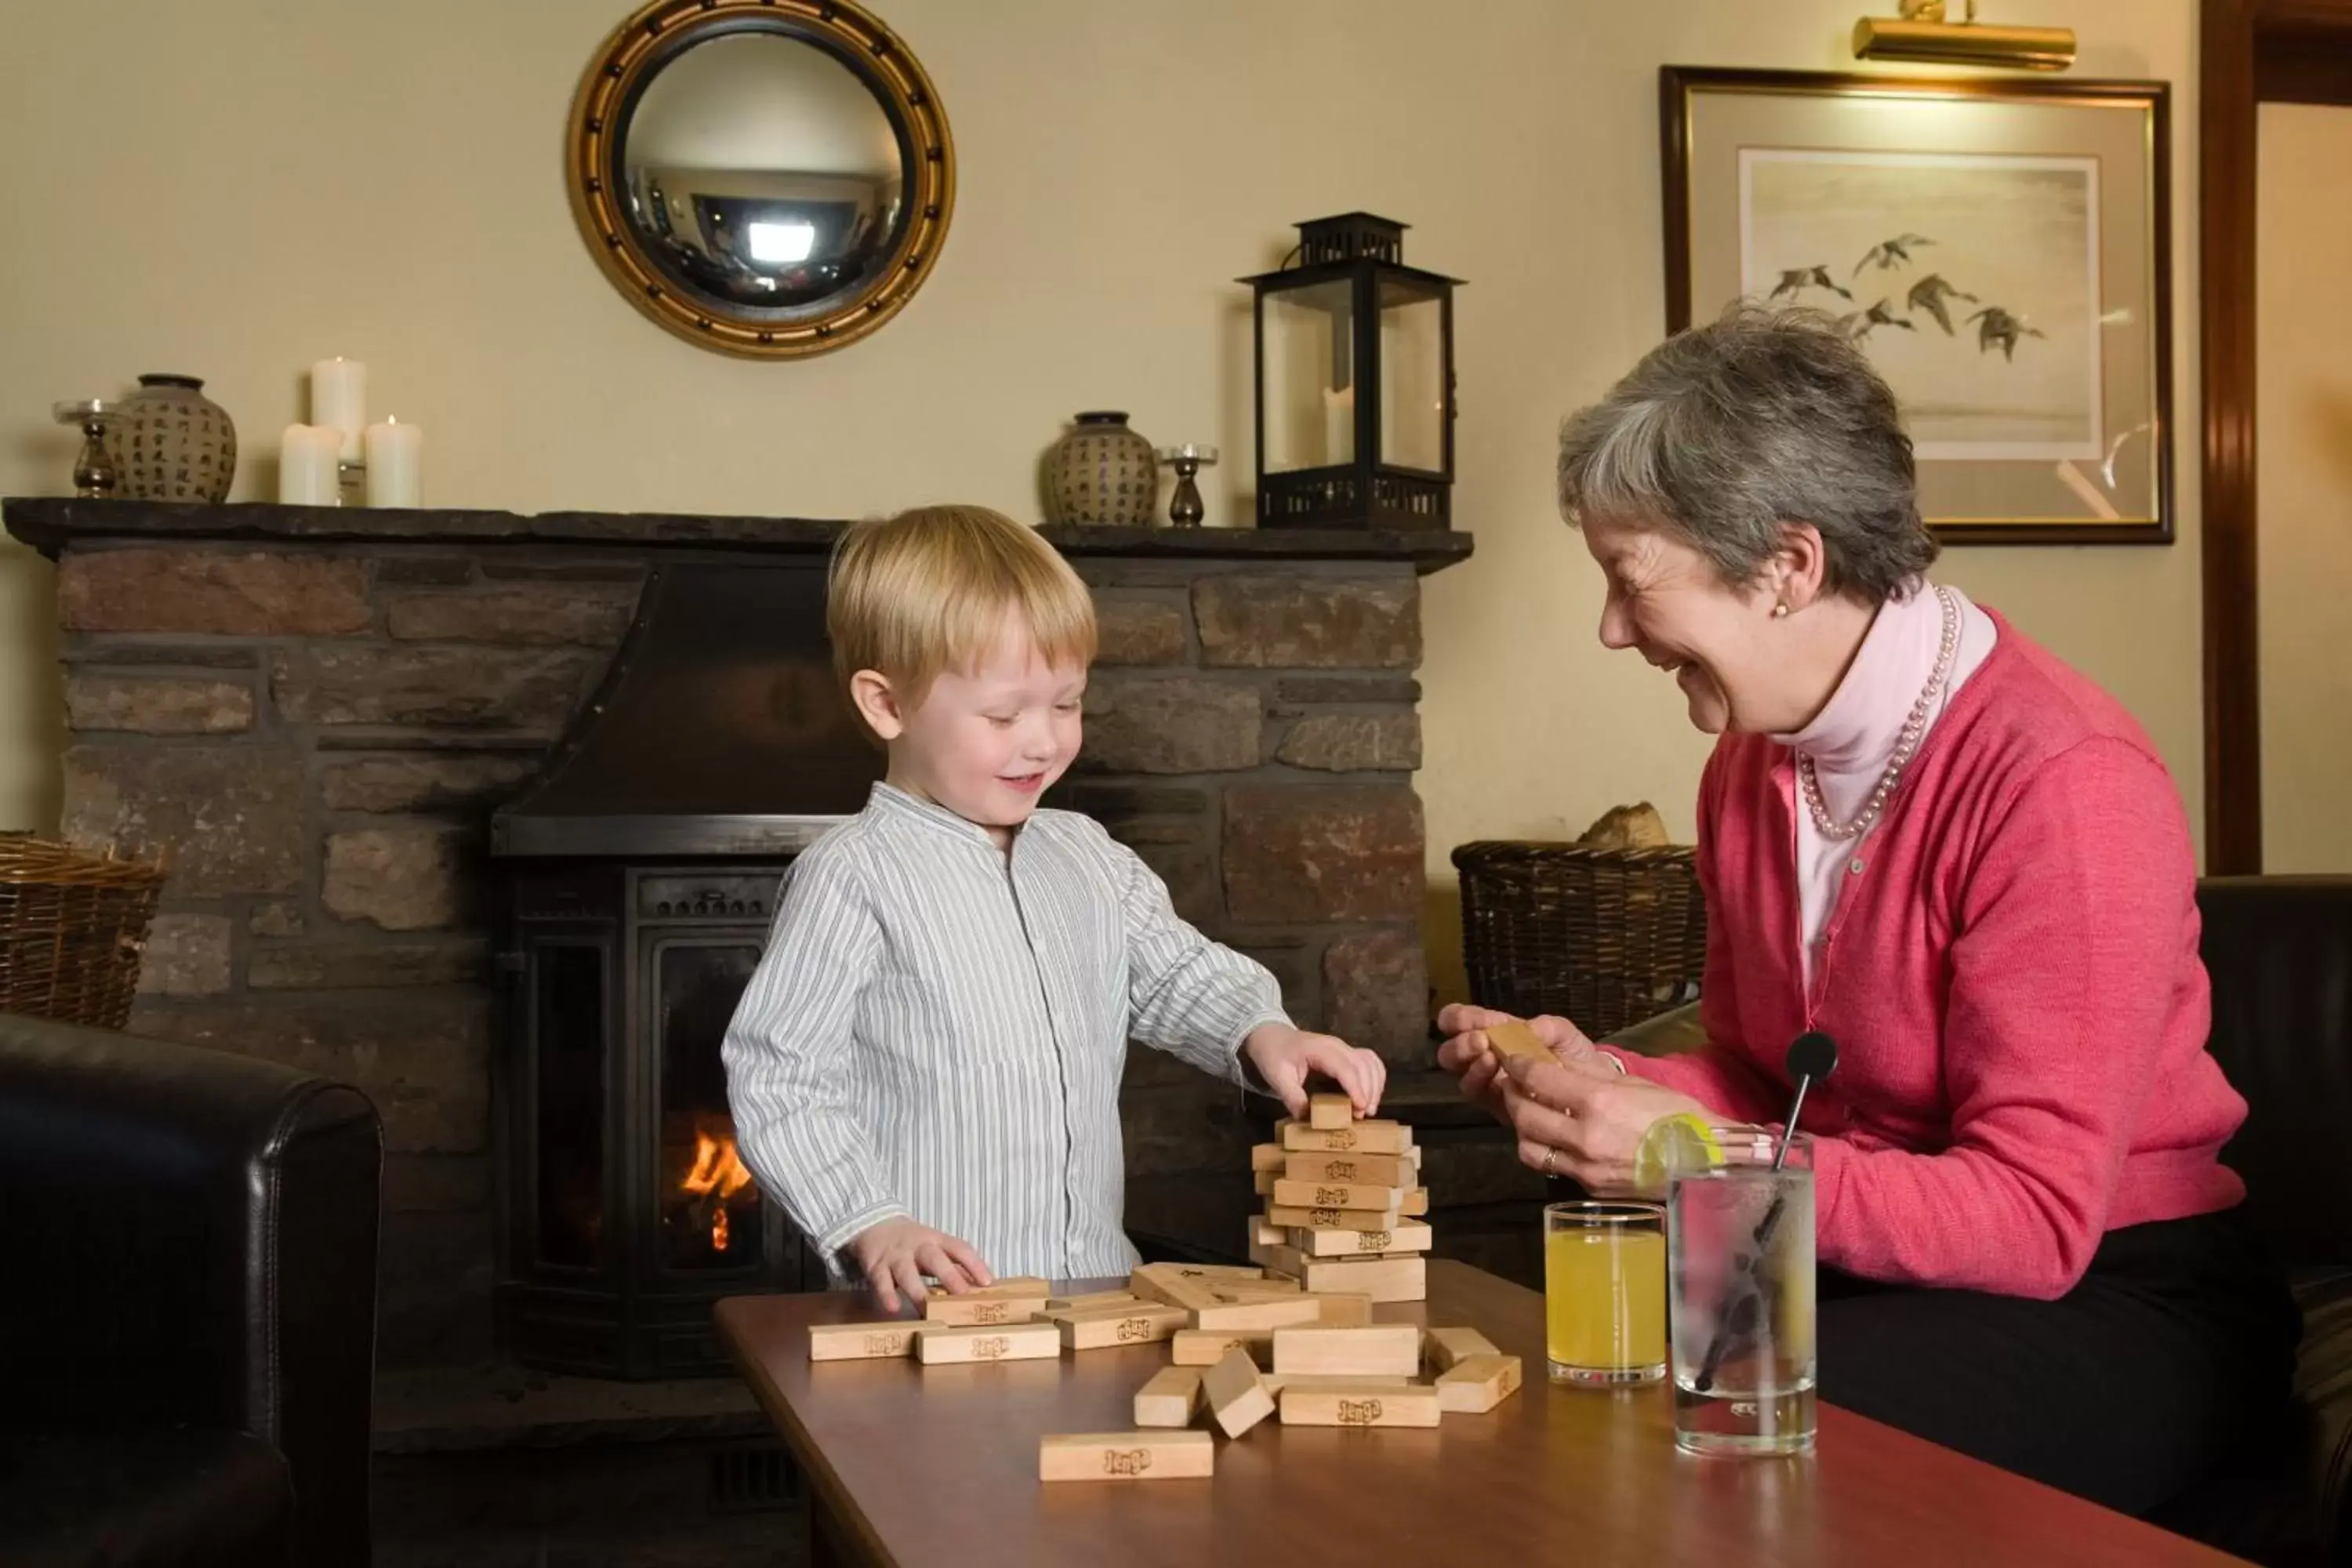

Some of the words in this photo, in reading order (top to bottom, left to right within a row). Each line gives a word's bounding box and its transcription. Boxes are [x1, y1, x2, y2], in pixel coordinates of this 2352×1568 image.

[1359, 1232, 1392, 1250] Jenga
[1337, 1399, 1381, 1425] Jenga
[1102, 1448, 1152, 1475] Jenga
